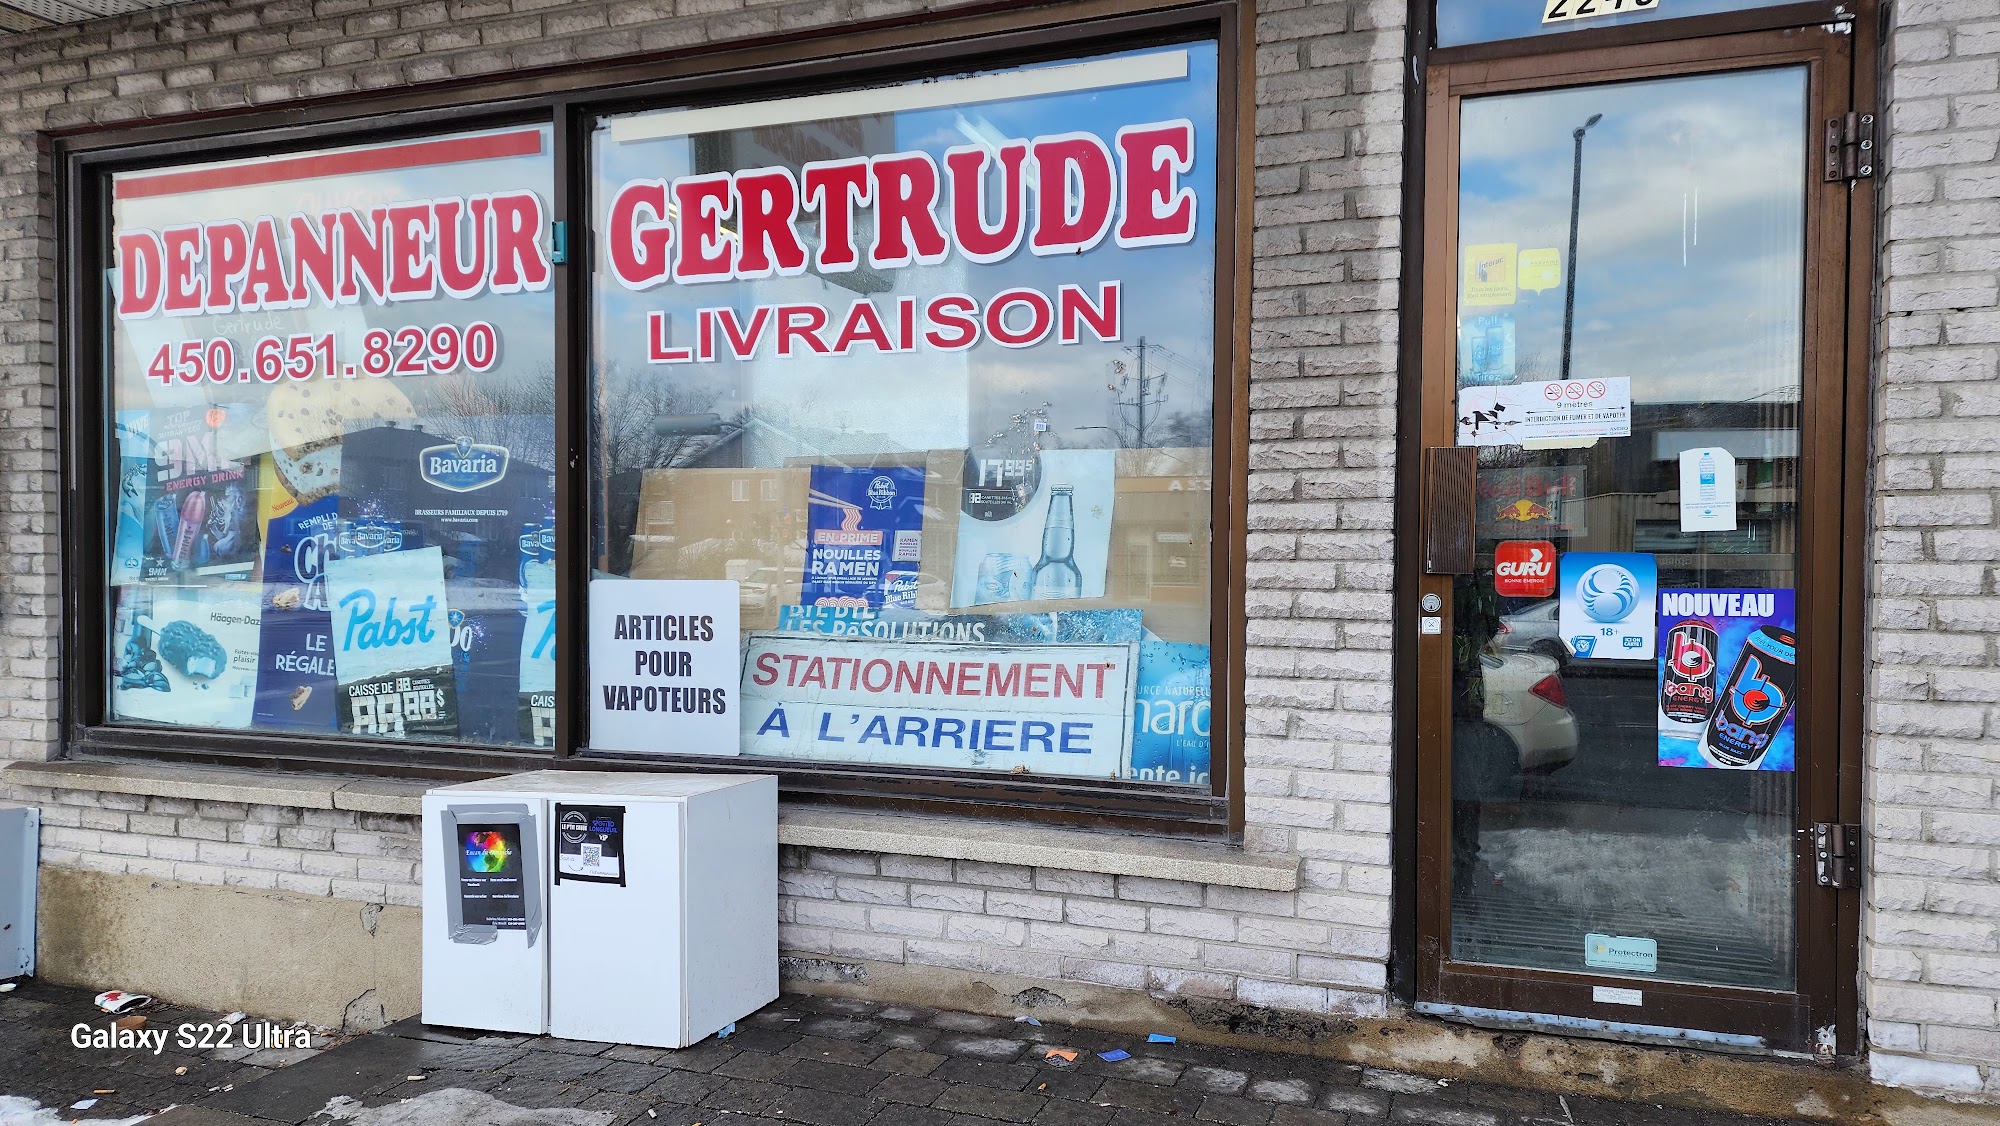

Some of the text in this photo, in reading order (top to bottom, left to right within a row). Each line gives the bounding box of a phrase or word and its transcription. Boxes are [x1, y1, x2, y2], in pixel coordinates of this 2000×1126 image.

[608, 120, 1197, 289] GERTRUDE
[118, 191, 551, 319] DEPANNEUR
[647, 280, 1122, 364] LIVRAISON
[1478, 316, 1498, 325] Pull
[147, 321, 498, 387] 450.651.8290
[430, 454, 498, 475] Bavaria
[166, 476, 207, 491] ENERGY
[297, 514, 330, 530] REMPLI
[357, 531, 383, 541] Bavaria
[817, 532, 878, 543] EN PRIME
[521, 540, 540, 548] Bava
[812, 548, 881, 560] NOUILLES
[811, 561, 880, 576] RAMEN
[1496, 562, 1552, 577] GURU
[893, 578, 918, 592] Pabst
[885, 593, 902, 604] Blue
[902, 590, 918, 600] Rib
[1662, 593, 1775, 617] NOUVEAU
[210, 612, 261, 626] Häagen-Daz
[338, 588, 438, 652] Pabst
[613, 614, 714, 642] ARTICLES
[1600, 627, 1619, 636] 18+
[306, 633, 327, 652] LE
[1767, 643, 1784, 654] YOUR
[233, 655, 256, 663] plaisir
[275, 651, 335, 676] RÉGALE
[635, 650, 692, 677] POUR
[752, 652, 1116, 699] STATIONNEMENT
[349, 683, 381, 697] CAISSE
[381, 682, 394, 694] DE
[1137, 685, 1210, 697] URCE NATURELL
[1664, 680, 1713, 703] bang
[531, 694, 555, 708] CAIS
[602, 685, 726, 715] VAPOTEURS
[757, 702, 1094, 754] À L'ARRIERE
[1716, 709, 1770, 749] bang
[1719, 732, 1754, 750] ENERGY
[1608, 947, 1653, 958] Protectron
